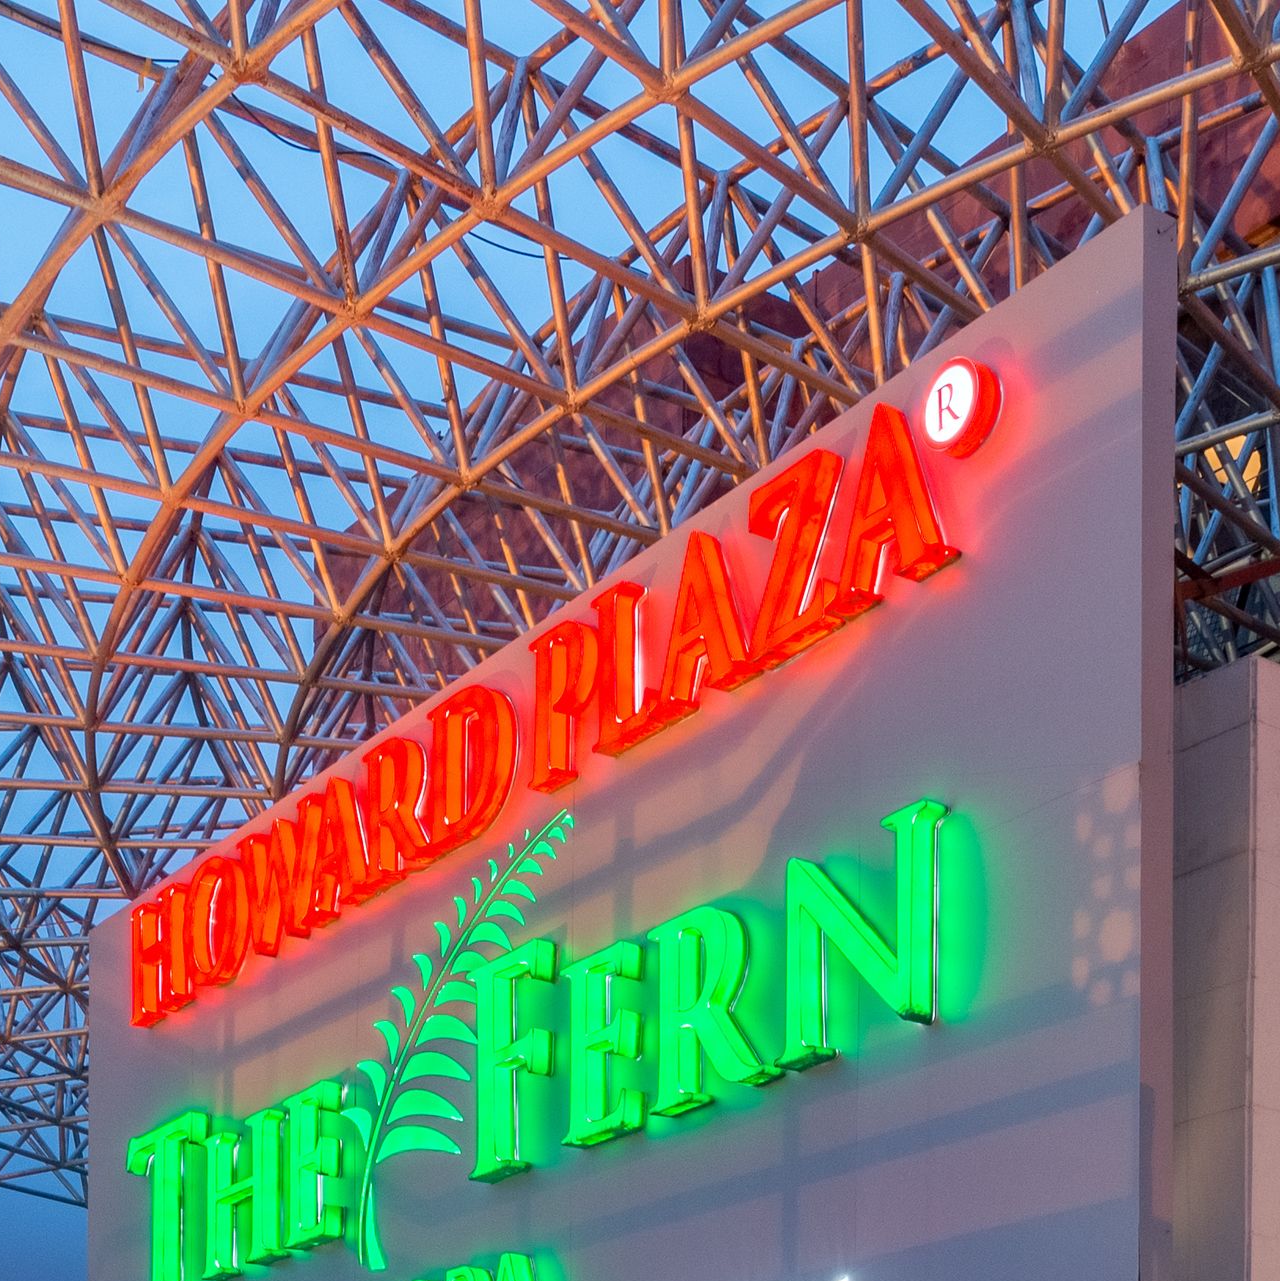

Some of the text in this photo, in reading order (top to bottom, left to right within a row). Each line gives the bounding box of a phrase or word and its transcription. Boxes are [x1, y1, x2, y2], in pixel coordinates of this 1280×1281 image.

[131, 685, 518, 1026] HOWARD
[530, 403, 962, 791] PLAZA
[469, 800, 951, 1182] FERN
